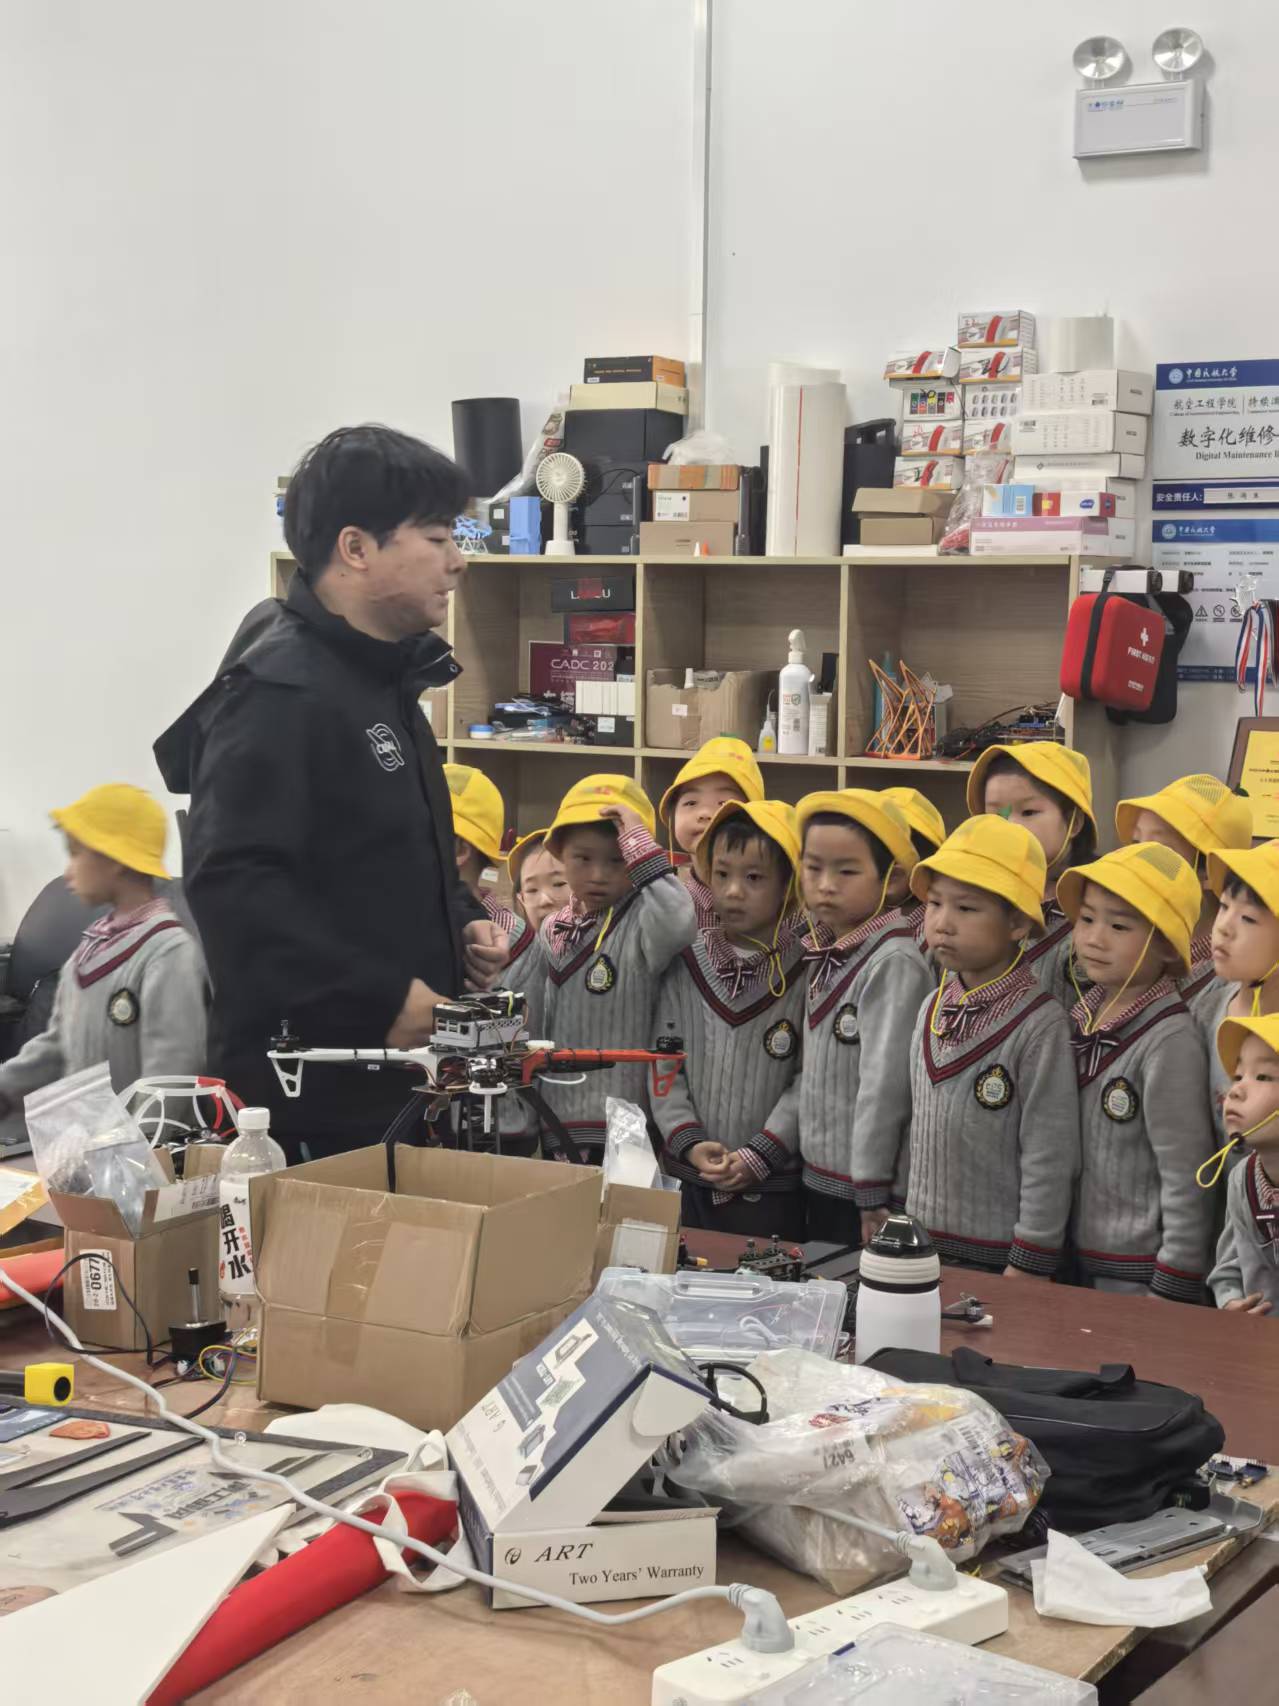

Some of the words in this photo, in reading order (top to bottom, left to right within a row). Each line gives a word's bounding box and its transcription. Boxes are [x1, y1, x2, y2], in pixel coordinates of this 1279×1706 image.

[1196, 451, 1221, 461] Digital
[1223, 449, 1273, 459] Maintenance
[551, 659, 590, 670] CADC
[592, 661, 616, 671] 202
[89, 1258, 102, 1290] 0677
[534, 1543, 593, 1563] ART
[569, 1572, 598, 1586] Two
[648, 1564, 705, 1579] Warranty
